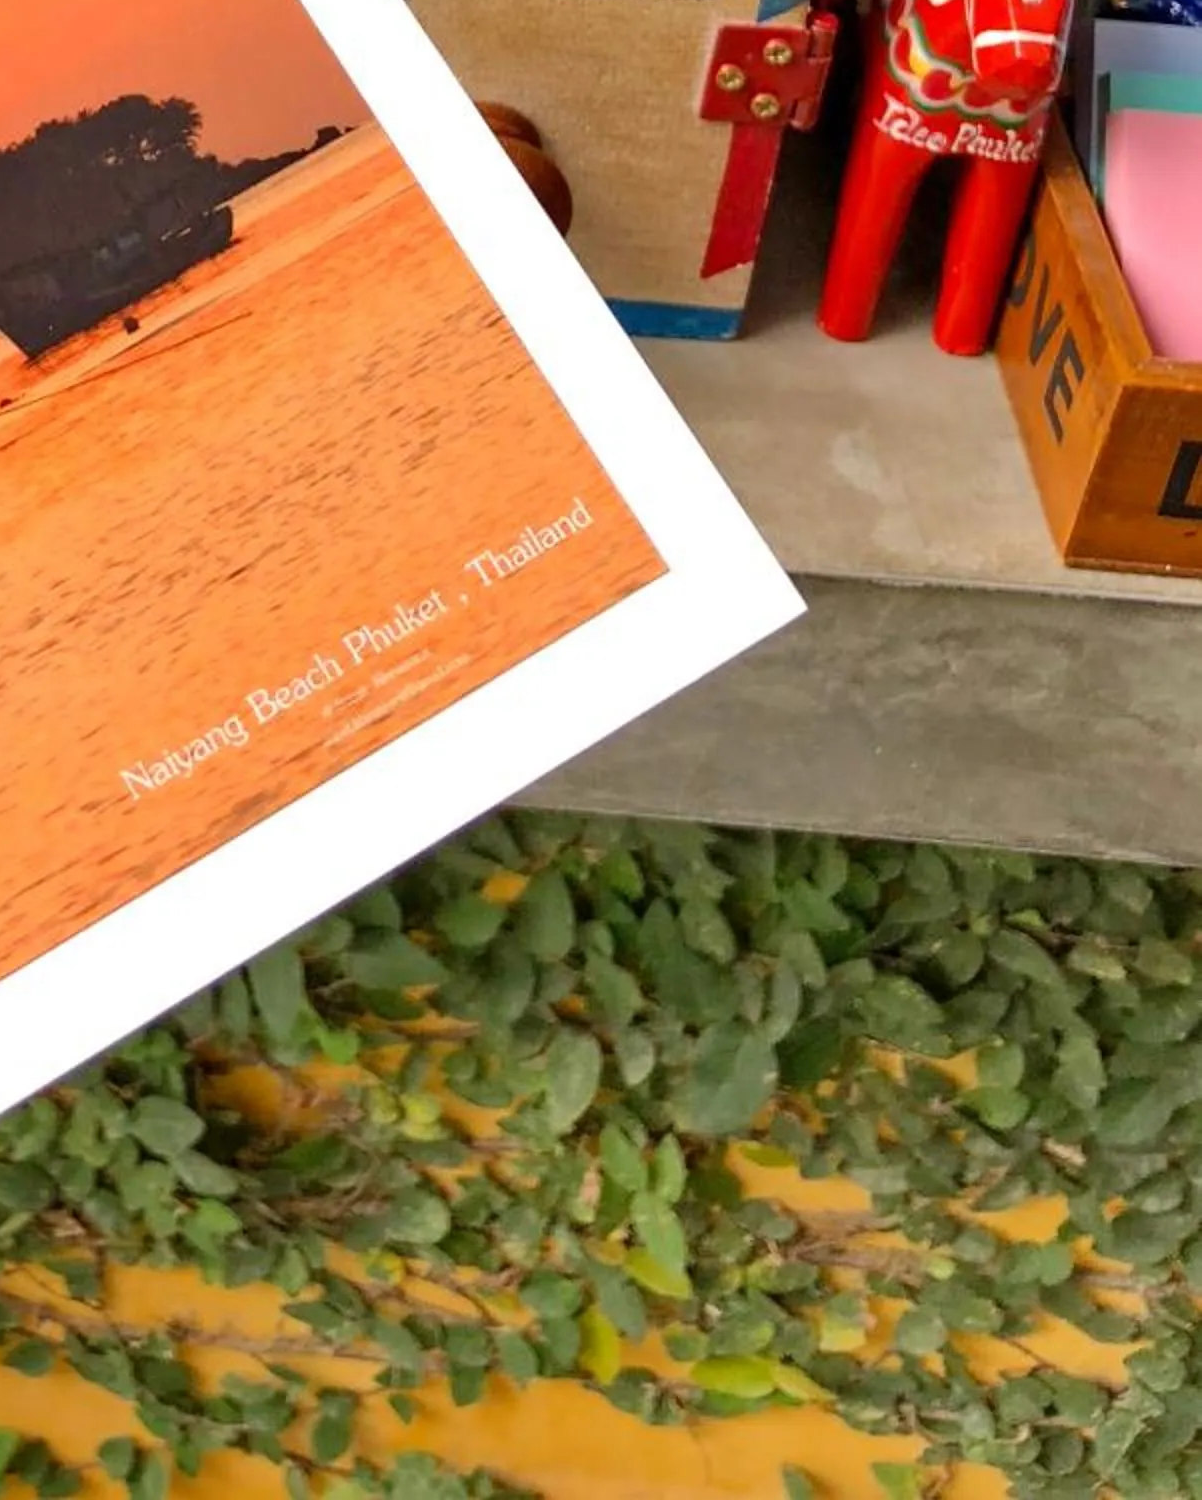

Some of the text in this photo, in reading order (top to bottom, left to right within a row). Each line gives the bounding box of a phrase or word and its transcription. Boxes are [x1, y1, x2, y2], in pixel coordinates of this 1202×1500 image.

[119, 713, 250, 801] Naiyang
[245, 651, 345, 727] Beach
[341, 587, 449, 665] Phuket
[463, 496, 595, 589] Thailand
